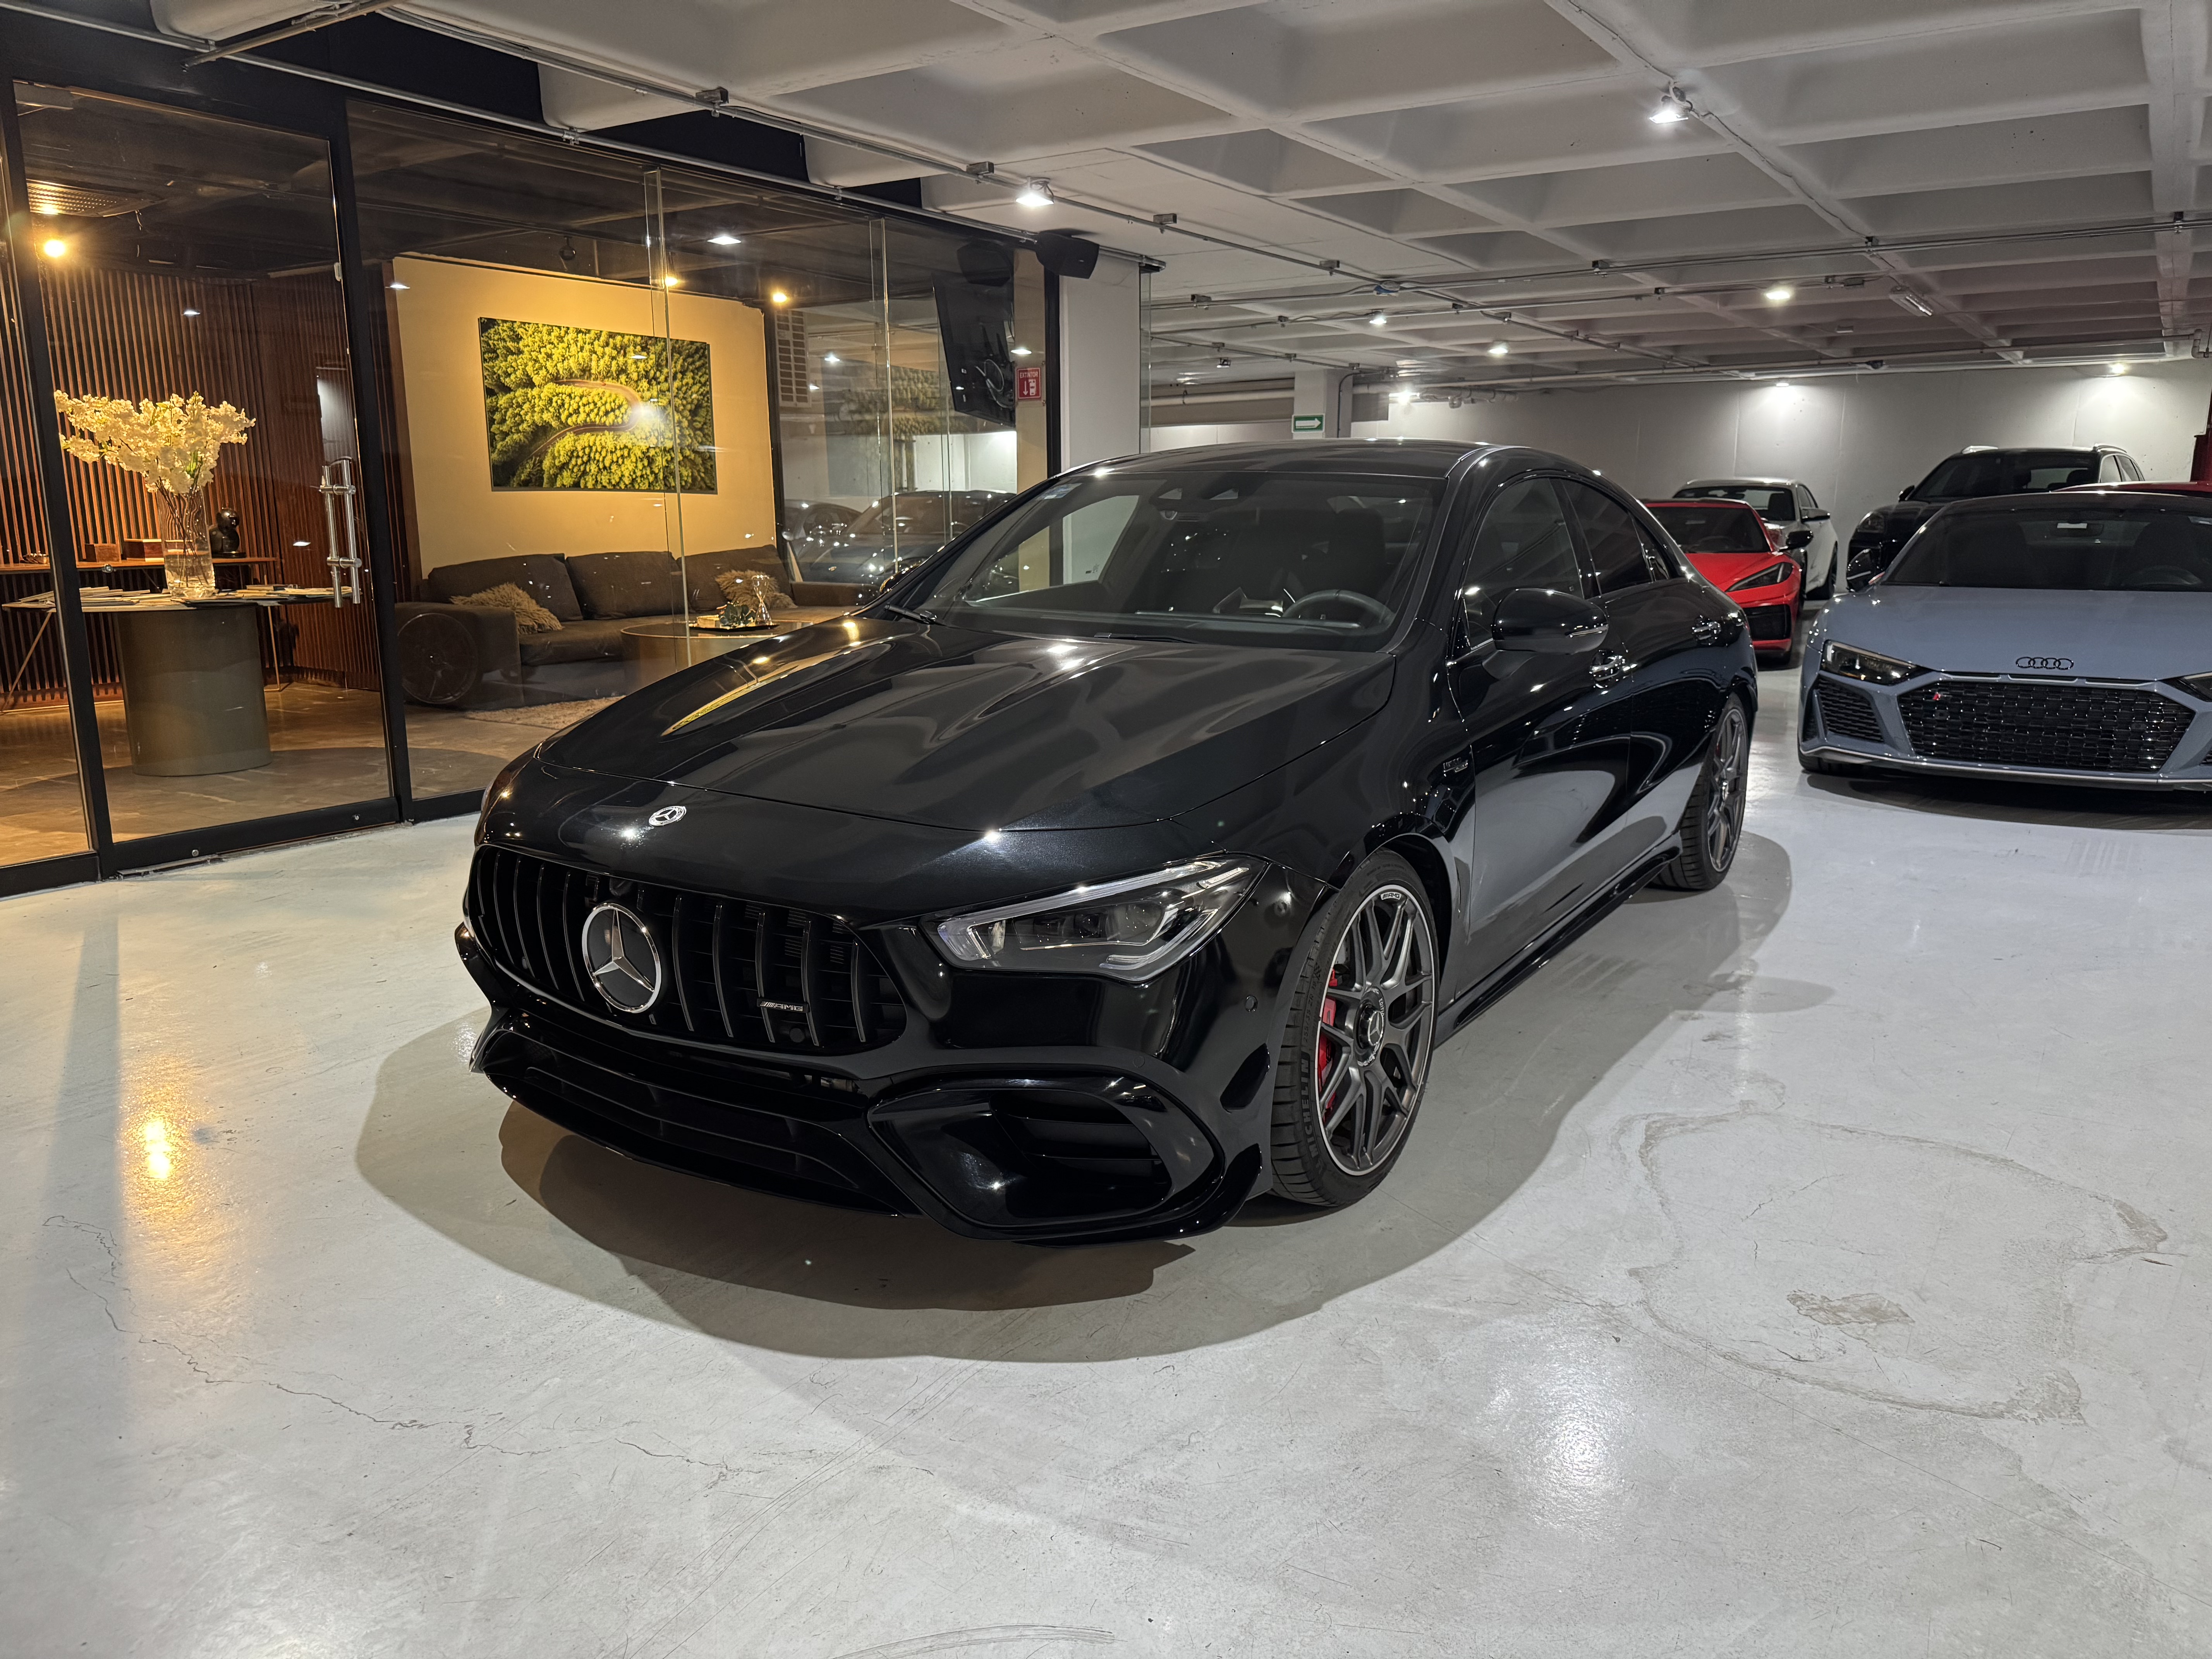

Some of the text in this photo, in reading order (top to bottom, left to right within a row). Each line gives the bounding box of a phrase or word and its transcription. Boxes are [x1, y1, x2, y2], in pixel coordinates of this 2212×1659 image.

[1308, 993, 1314, 1006] ZR
[773, 1003, 803, 1012] AMG
[1301, 1058, 1319, 1158] MICHELIN
